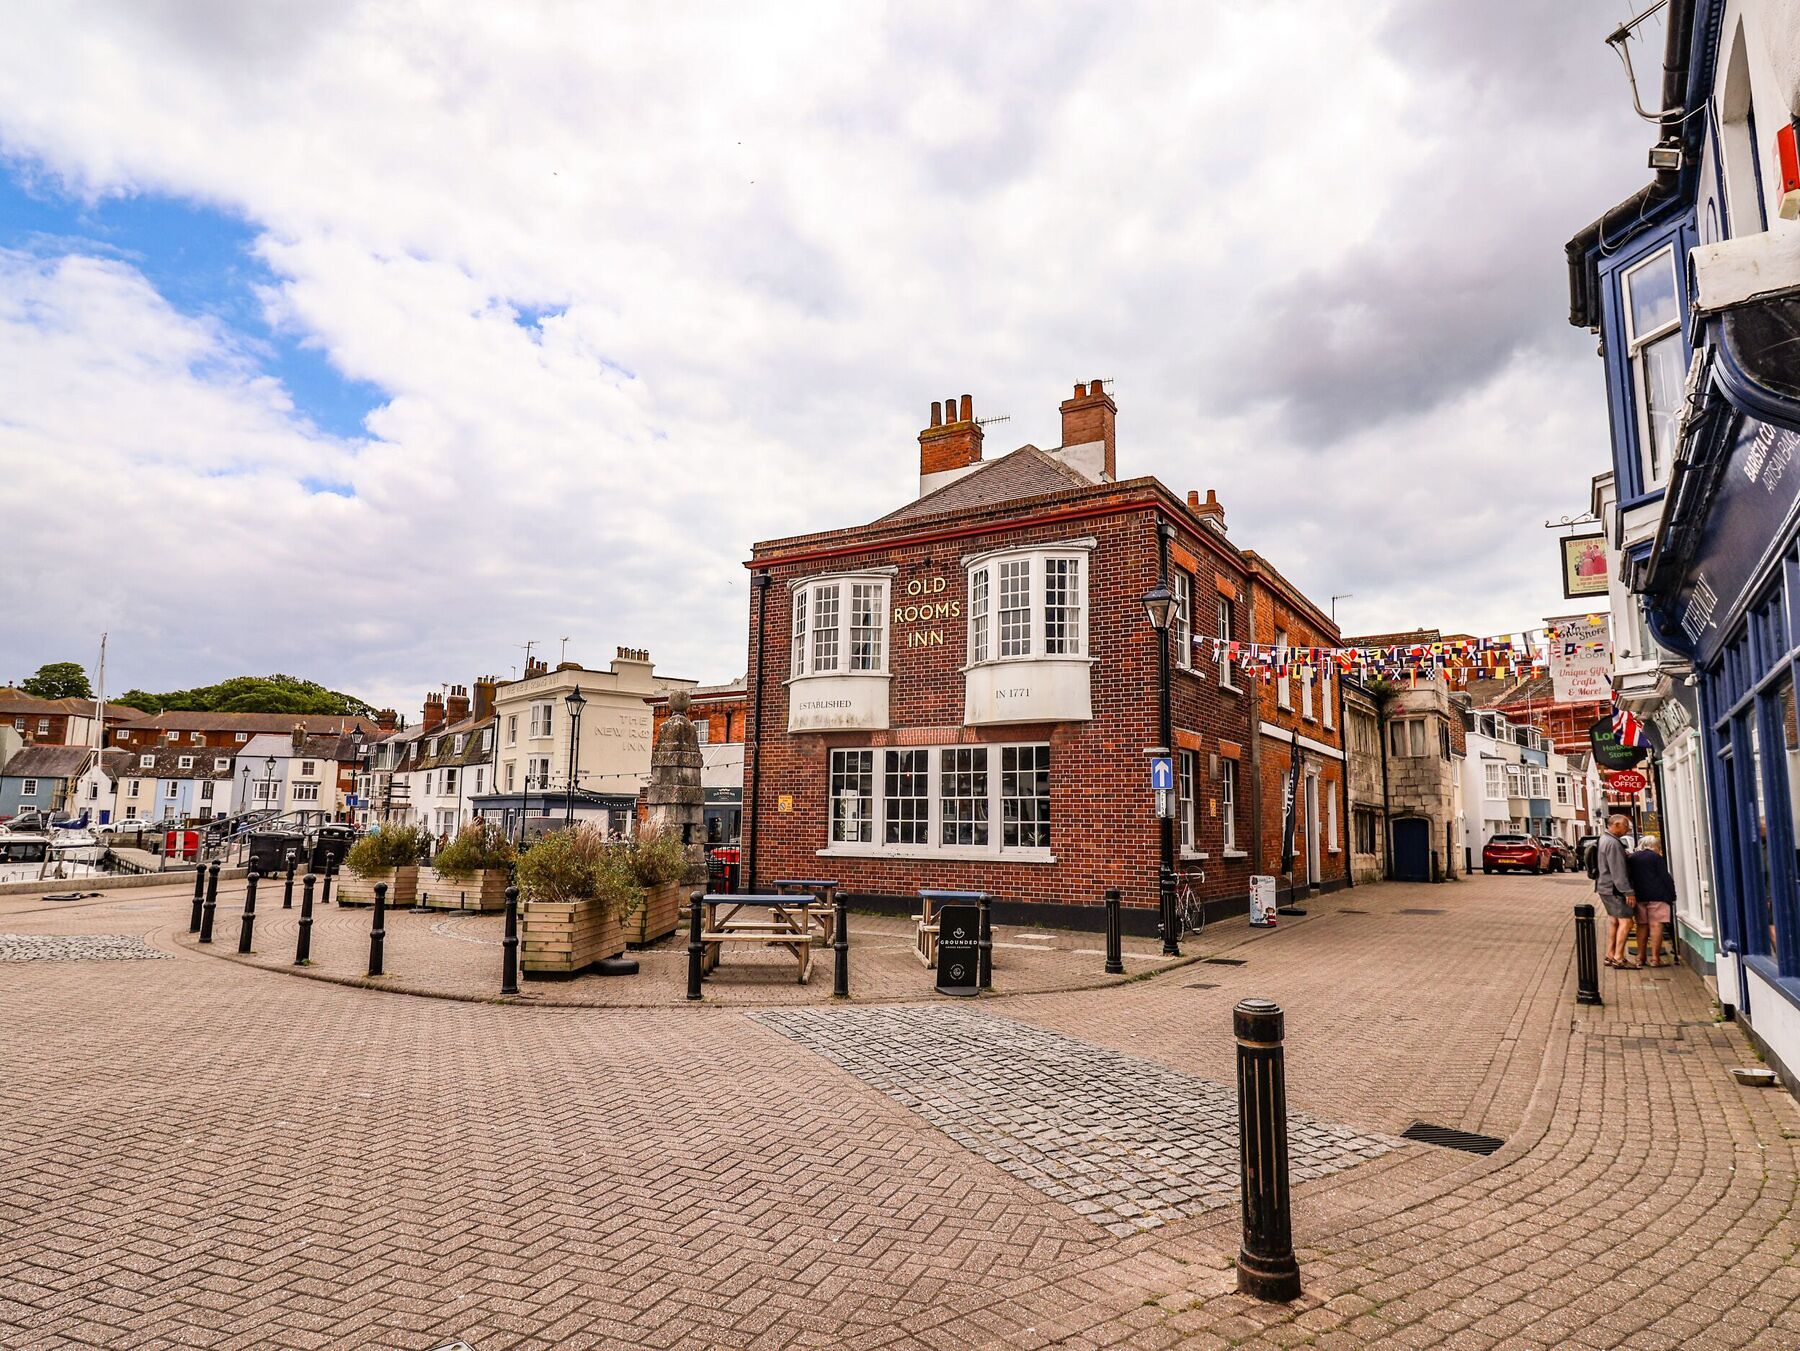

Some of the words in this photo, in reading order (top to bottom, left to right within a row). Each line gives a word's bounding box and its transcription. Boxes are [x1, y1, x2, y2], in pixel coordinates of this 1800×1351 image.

[1743, 436, 1769, 483] BARISTA
[1762, 448, 1787, 496] ARTISAN
[1777, 428, 1800, 461] BAKE
[907, 577, 947, 596] OLD
[1691, 572, 1718, 629] QUAY
[894, 601, 961, 623] ROOMS
[1685, 600, 1707, 636] THE
[908, 629, 945, 648] INN
[1579, 627, 1607, 641] Shore
[1559, 668, 1588, 678] Unique
[1589, 667, 1609, 676] Gifts
[1572, 678, 1597, 686] Crafts
[995, 690, 1006, 699] IN
[1009, 688, 1030, 698] 1771
[1577, 687, 1602, 696] More!
[799, 699, 852, 710] ESTABLISHED
[619, 715, 649, 726] THE
[594, 726, 625, 737] NEW
[622, 741, 647, 752] INN
[1608, 751, 1633, 759] Stores
